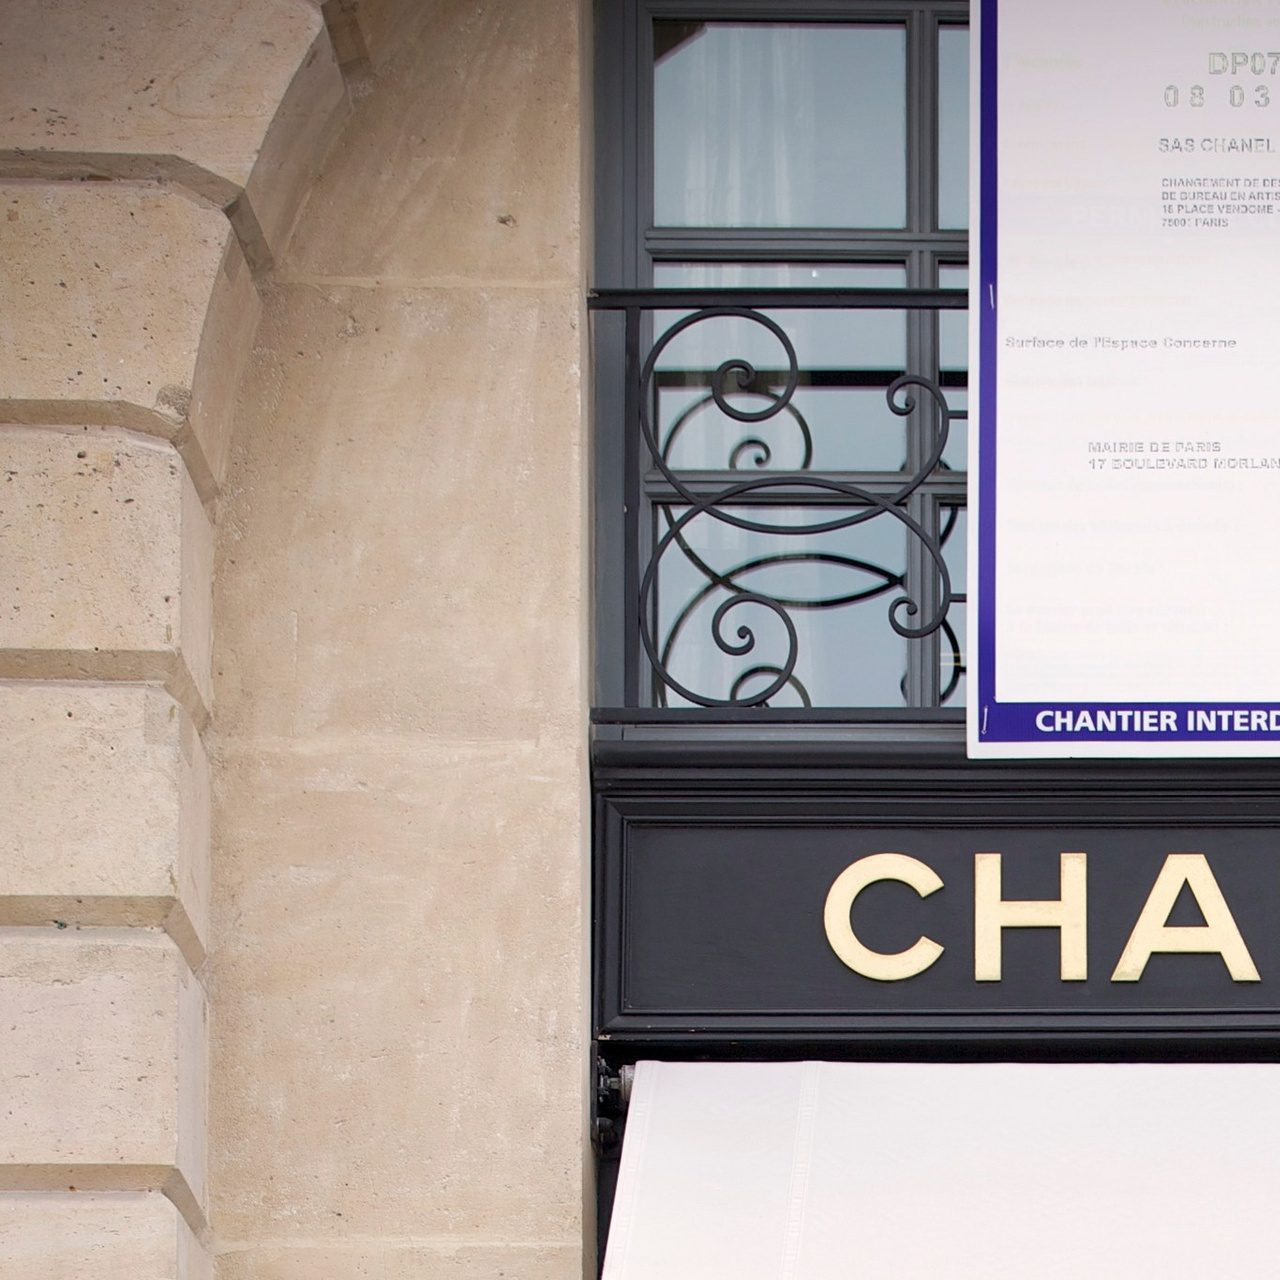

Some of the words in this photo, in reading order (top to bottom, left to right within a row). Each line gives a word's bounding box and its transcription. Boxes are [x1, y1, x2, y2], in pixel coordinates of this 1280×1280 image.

[1158, 138, 1195, 153] SAS
[1200, 137, 1276, 153] CHANEL
[1161, 178, 1241, 188] CHANGEMENT
[1244, 178, 1260, 188] DE
[1161, 191, 1177, 201] DE
[1177, 204, 1214, 215] PLACE
[1217, 204, 1274, 215] VENDOME
[1005, 336, 1066, 349] Surface
[1068, 336, 1089, 349] de
[1088, 442, 1145, 453] MAIRIE
[1149, 442, 1171, 453] DE
[1175, 442, 1222, 453] PARIS
[1112, 458, 1208, 470] BOULEVARD
[1036, 711, 1178, 732] CHANTIER
